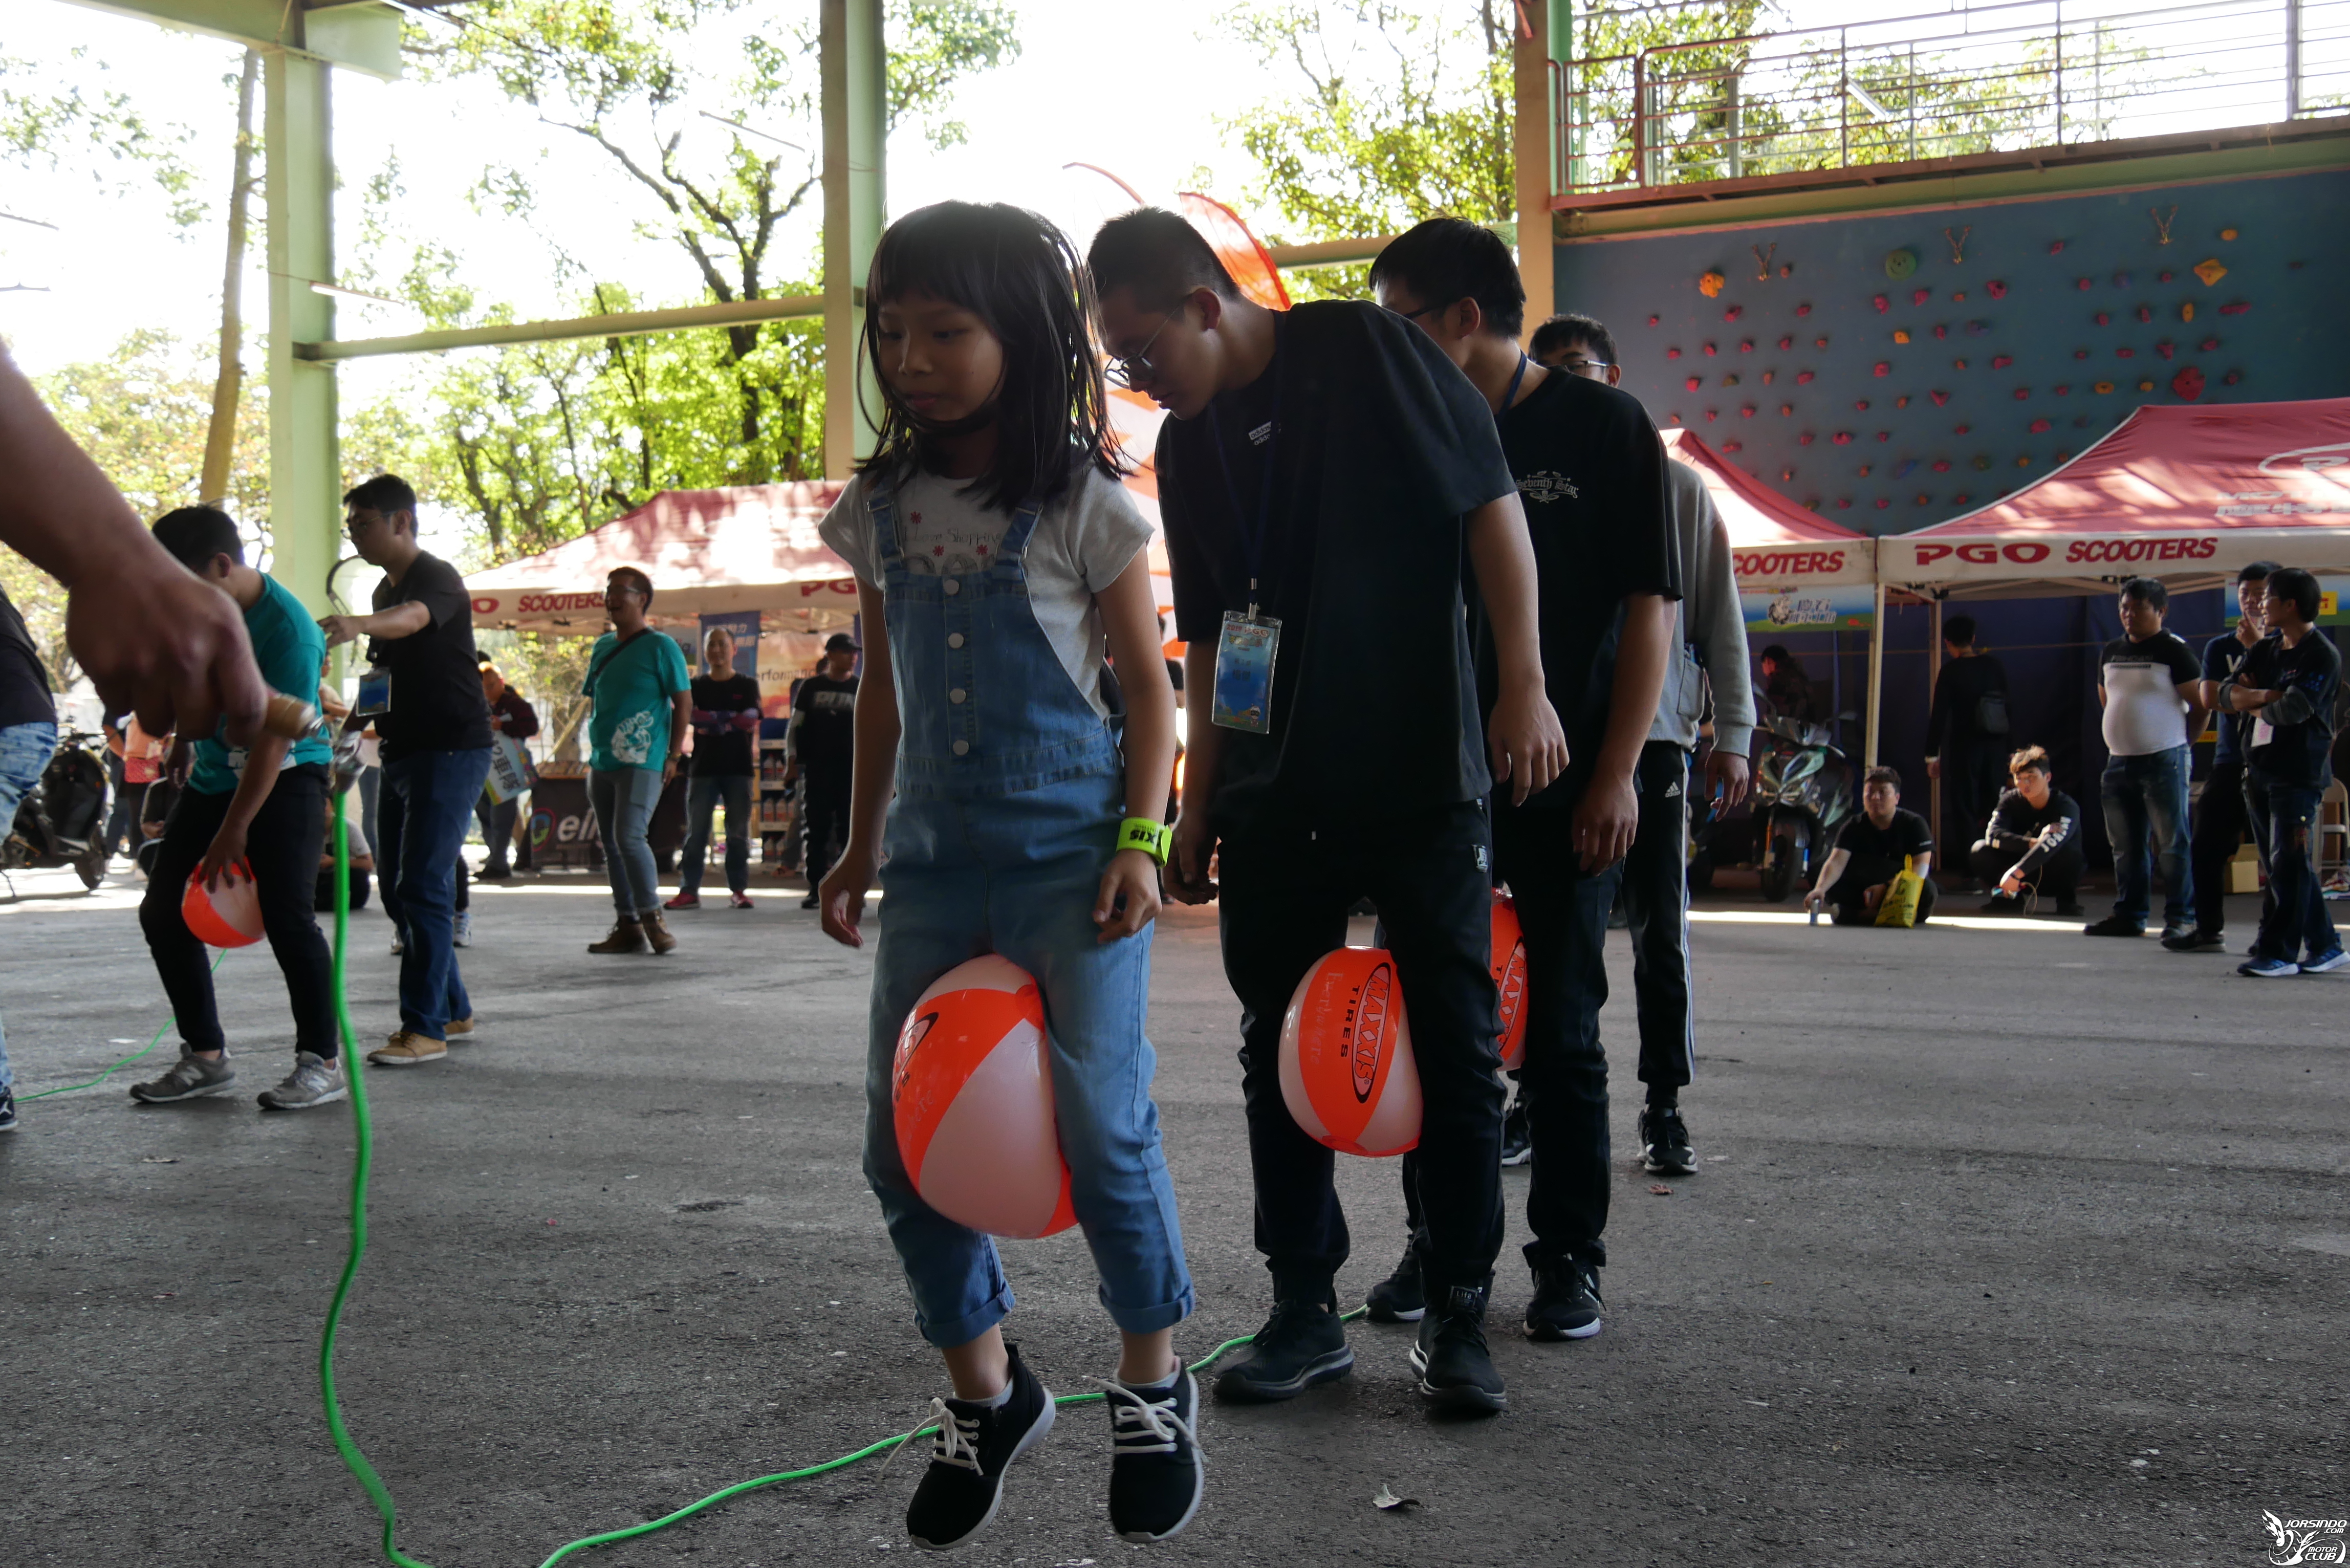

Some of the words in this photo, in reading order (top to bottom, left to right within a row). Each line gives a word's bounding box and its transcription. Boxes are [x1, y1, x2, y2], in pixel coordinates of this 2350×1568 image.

[1250, 425, 1271, 439] adidas
[1733, 551, 1845, 576] COOTERS
[1914, 542, 2051, 565] PGO
[2065, 537, 2218, 563] SCOOTERS
[800, 578, 857, 597] PG
[1340, 985, 1360, 1058] TIRES
[1355, 974, 1388, 1081] MAXXIS
